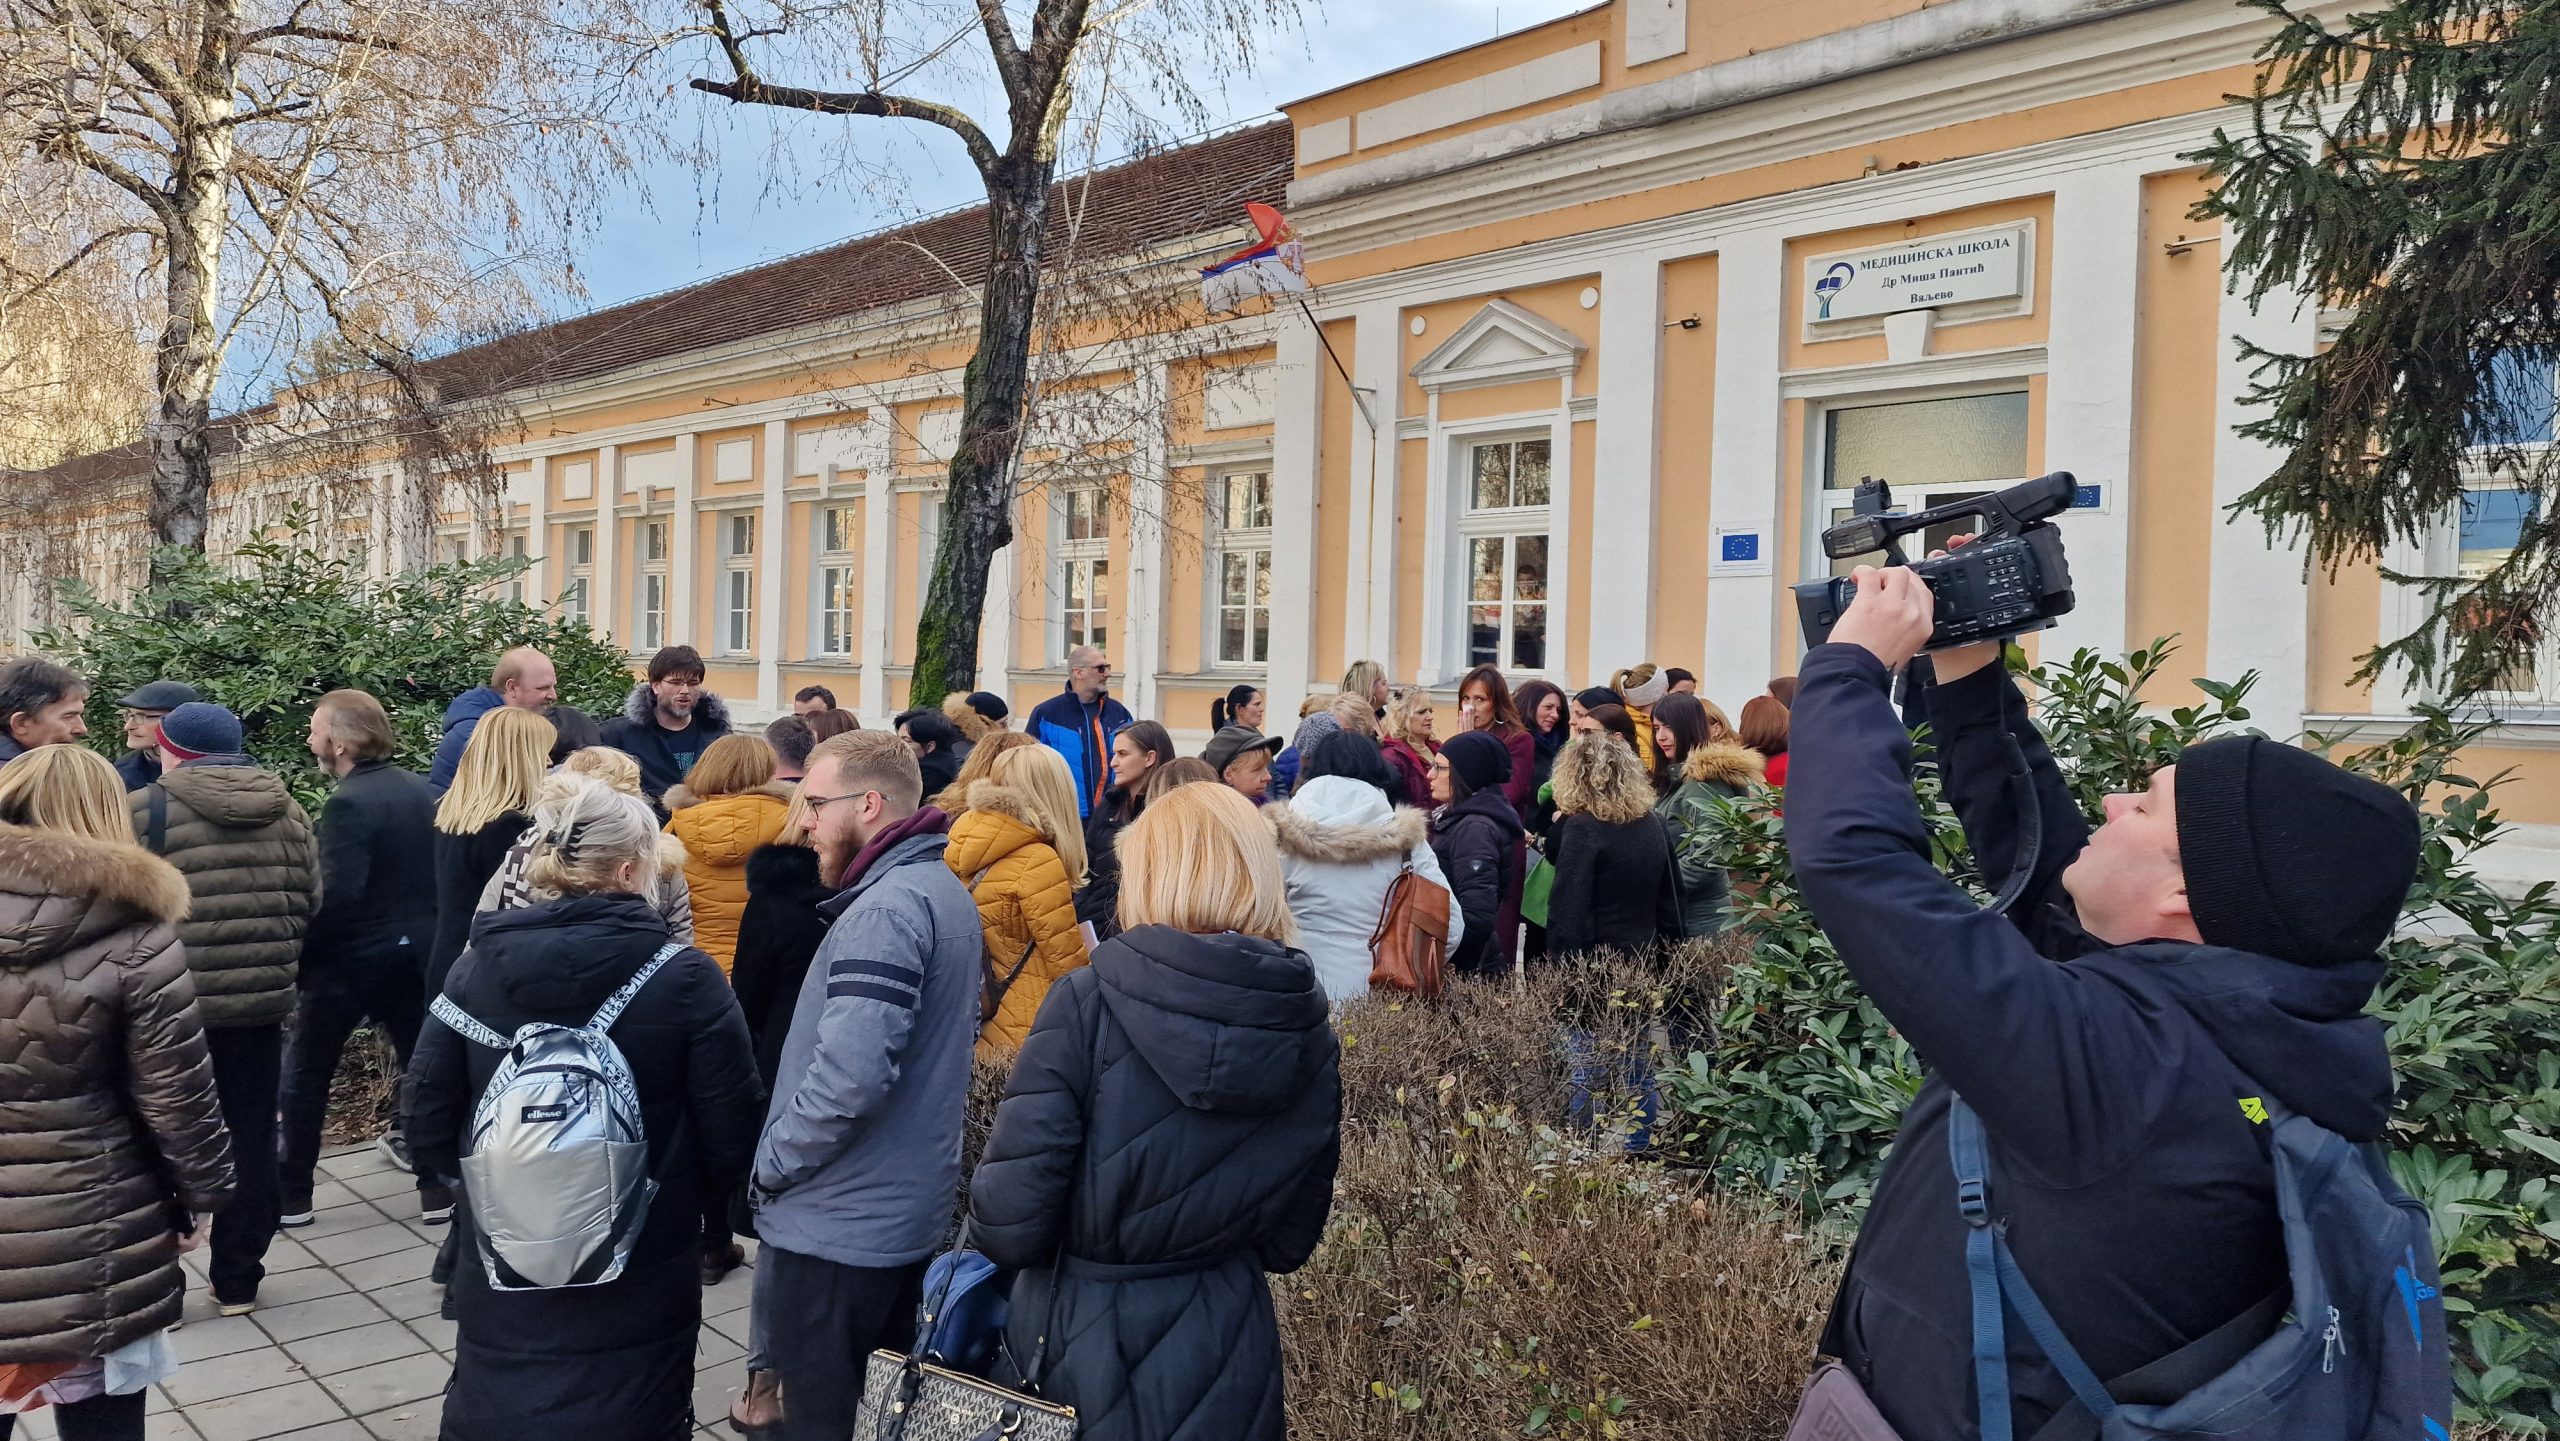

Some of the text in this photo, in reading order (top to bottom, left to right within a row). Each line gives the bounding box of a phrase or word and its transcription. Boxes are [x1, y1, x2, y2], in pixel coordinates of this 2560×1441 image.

[1860, 237, 2010, 270] МЕДИЦИНСКА ШКОЛА
[1881, 264, 1985, 289] Др Миша Пантић
[1910, 290, 1953, 304] Ваљево
[527, 1109, 562, 1119] ellesse
